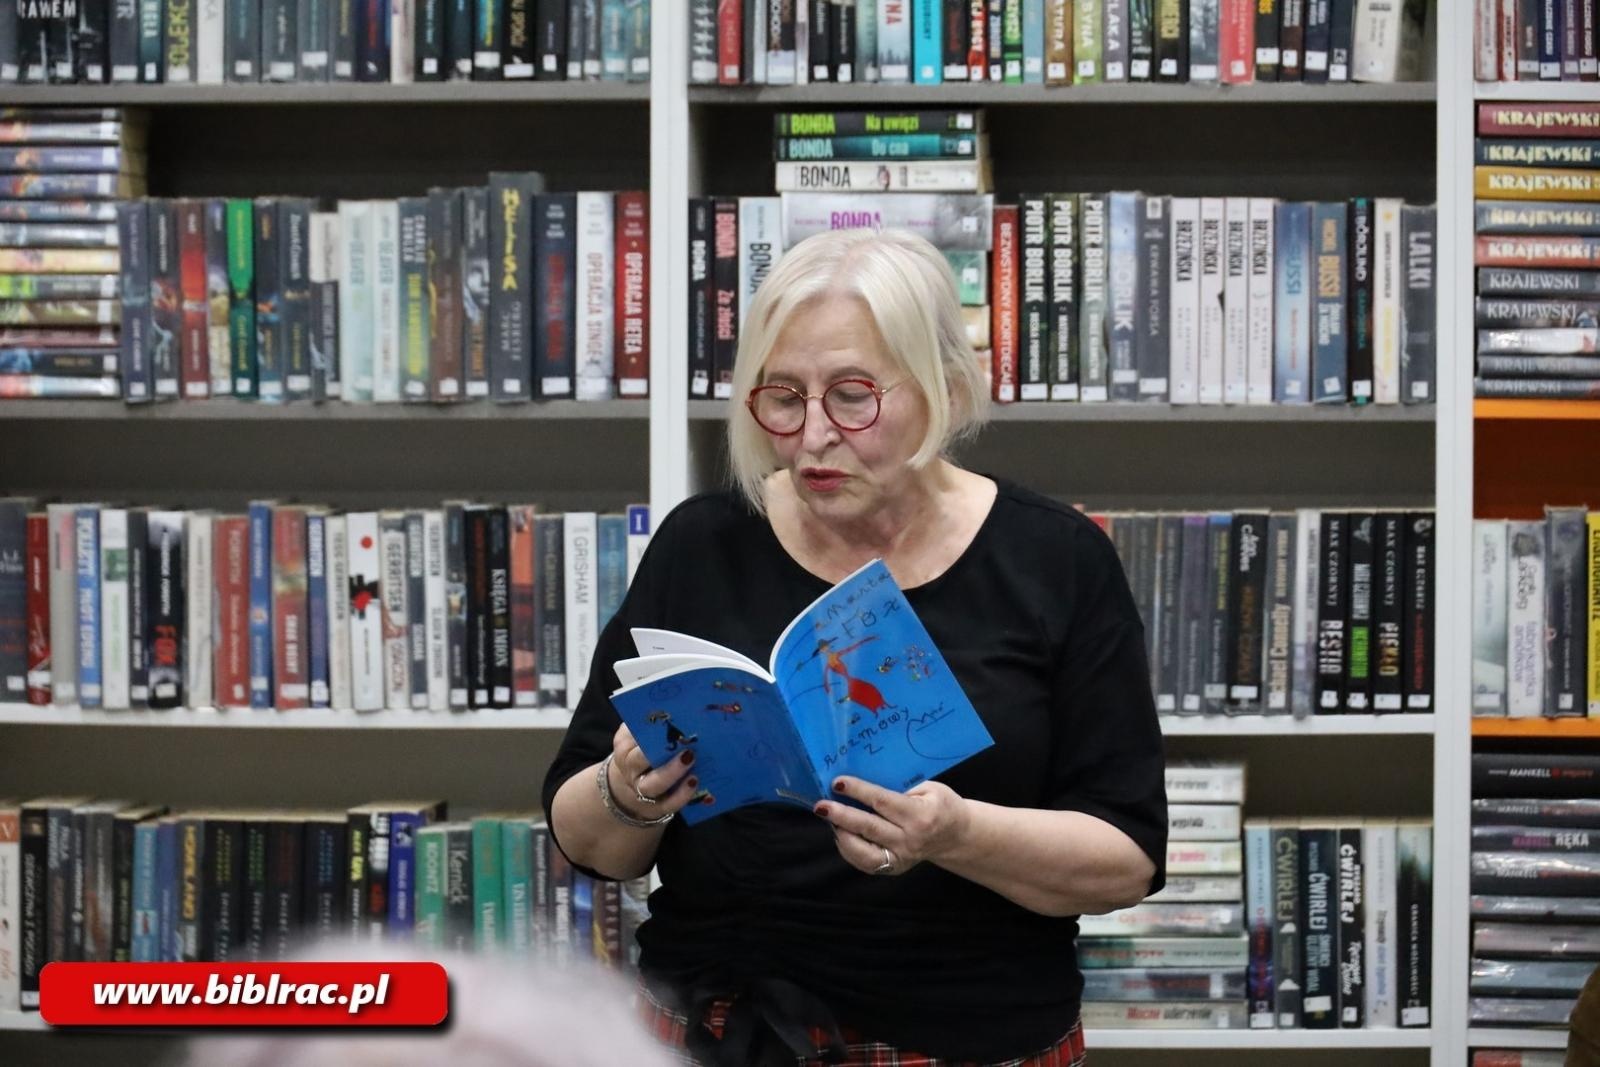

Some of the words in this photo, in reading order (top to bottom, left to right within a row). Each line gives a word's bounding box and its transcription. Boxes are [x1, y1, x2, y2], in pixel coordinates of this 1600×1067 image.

[791, 113, 836, 134] BONDA
[1497, 110, 1600, 128] KRAJEWSKI
[789, 138, 833, 158] BONDA
[1489, 145, 1591, 163] KRAJEWSKI
[800, 165, 851, 187] BONDA
[1489, 174, 1591, 192] KRAJEWSKI
[715, 213, 737, 258] BONDA
[1025, 200, 1044, 245] PIOTR
[1053, 200, 1072, 245] PIOTR
[1084, 200, 1103, 245] PIOTR
[1490, 208, 1592, 227] KRAJEWSKI
[692, 240, 706, 281] BONDA
[999, 222, 1013, 308] BEZWSTYDNY
[1176, 219, 1197, 282] BRZEZIŃSKA
[1203, 219, 1222, 276] BRZEZIŃSKA
[1409, 231, 1432, 290] LALKI
[1488, 242, 1591, 260] KRAJEWSKI
[587, 251, 604, 315] OPERACJA
[624, 251, 643, 315] OPERACJA
[1024, 247, 1044, 303] BORLIK
[1053, 247, 1072, 303] BORLIK
[1084, 247, 1104, 303] BORLIK
[1490, 274, 1579, 289] KRAJEWSKI
[501, 311, 510, 351] MARC
[1148, 299, 1161, 337] FORSA
[1487, 304, 1577, 319] KRAJEWSKI
[1240, 524, 1253, 572] Cleeves
[1249, 535, 1260, 557] Ann
[1330, 520, 1340, 548] MAX
[1386, 520, 1397, 548] MAX
[387, 543, 406, 614] GERRITSEN
[490, 568, 508, 615] KSIĘGA
[545, 553, 559, 609] GRISHAM
[574, 536, 590, 605] GRISHAM
[1327, 551, 1339, 606] CZORNYJ
[1384, 551, 1396, 606] CZORNYJ
[153, 623, 177, 666] FOX
[492, 628, 509, 668] IMION
[1319, 620, 1344, 674] BESTIA
[1525, 621, 1539, 698] fabrykantka
[1508, 767, 1551, 778] MANKELL
[48, 817, 61, 870] HAWKINS
[60, 826, 73, 859] PAULA
[1555, 831, 1590, 850] RĘKA
[425, 842, 440, 894] KOONTZ
[448, 849, 469, 905] Kernick
[1276, 837, 1298, 921] ĆWIRLEJ
[1340, 843, 1358, 924] ĆWIRLEJ
[1309, 872, 1331, 929] ĆWIRLEJ
[1410, 903, 1420, 941] GRANICA
